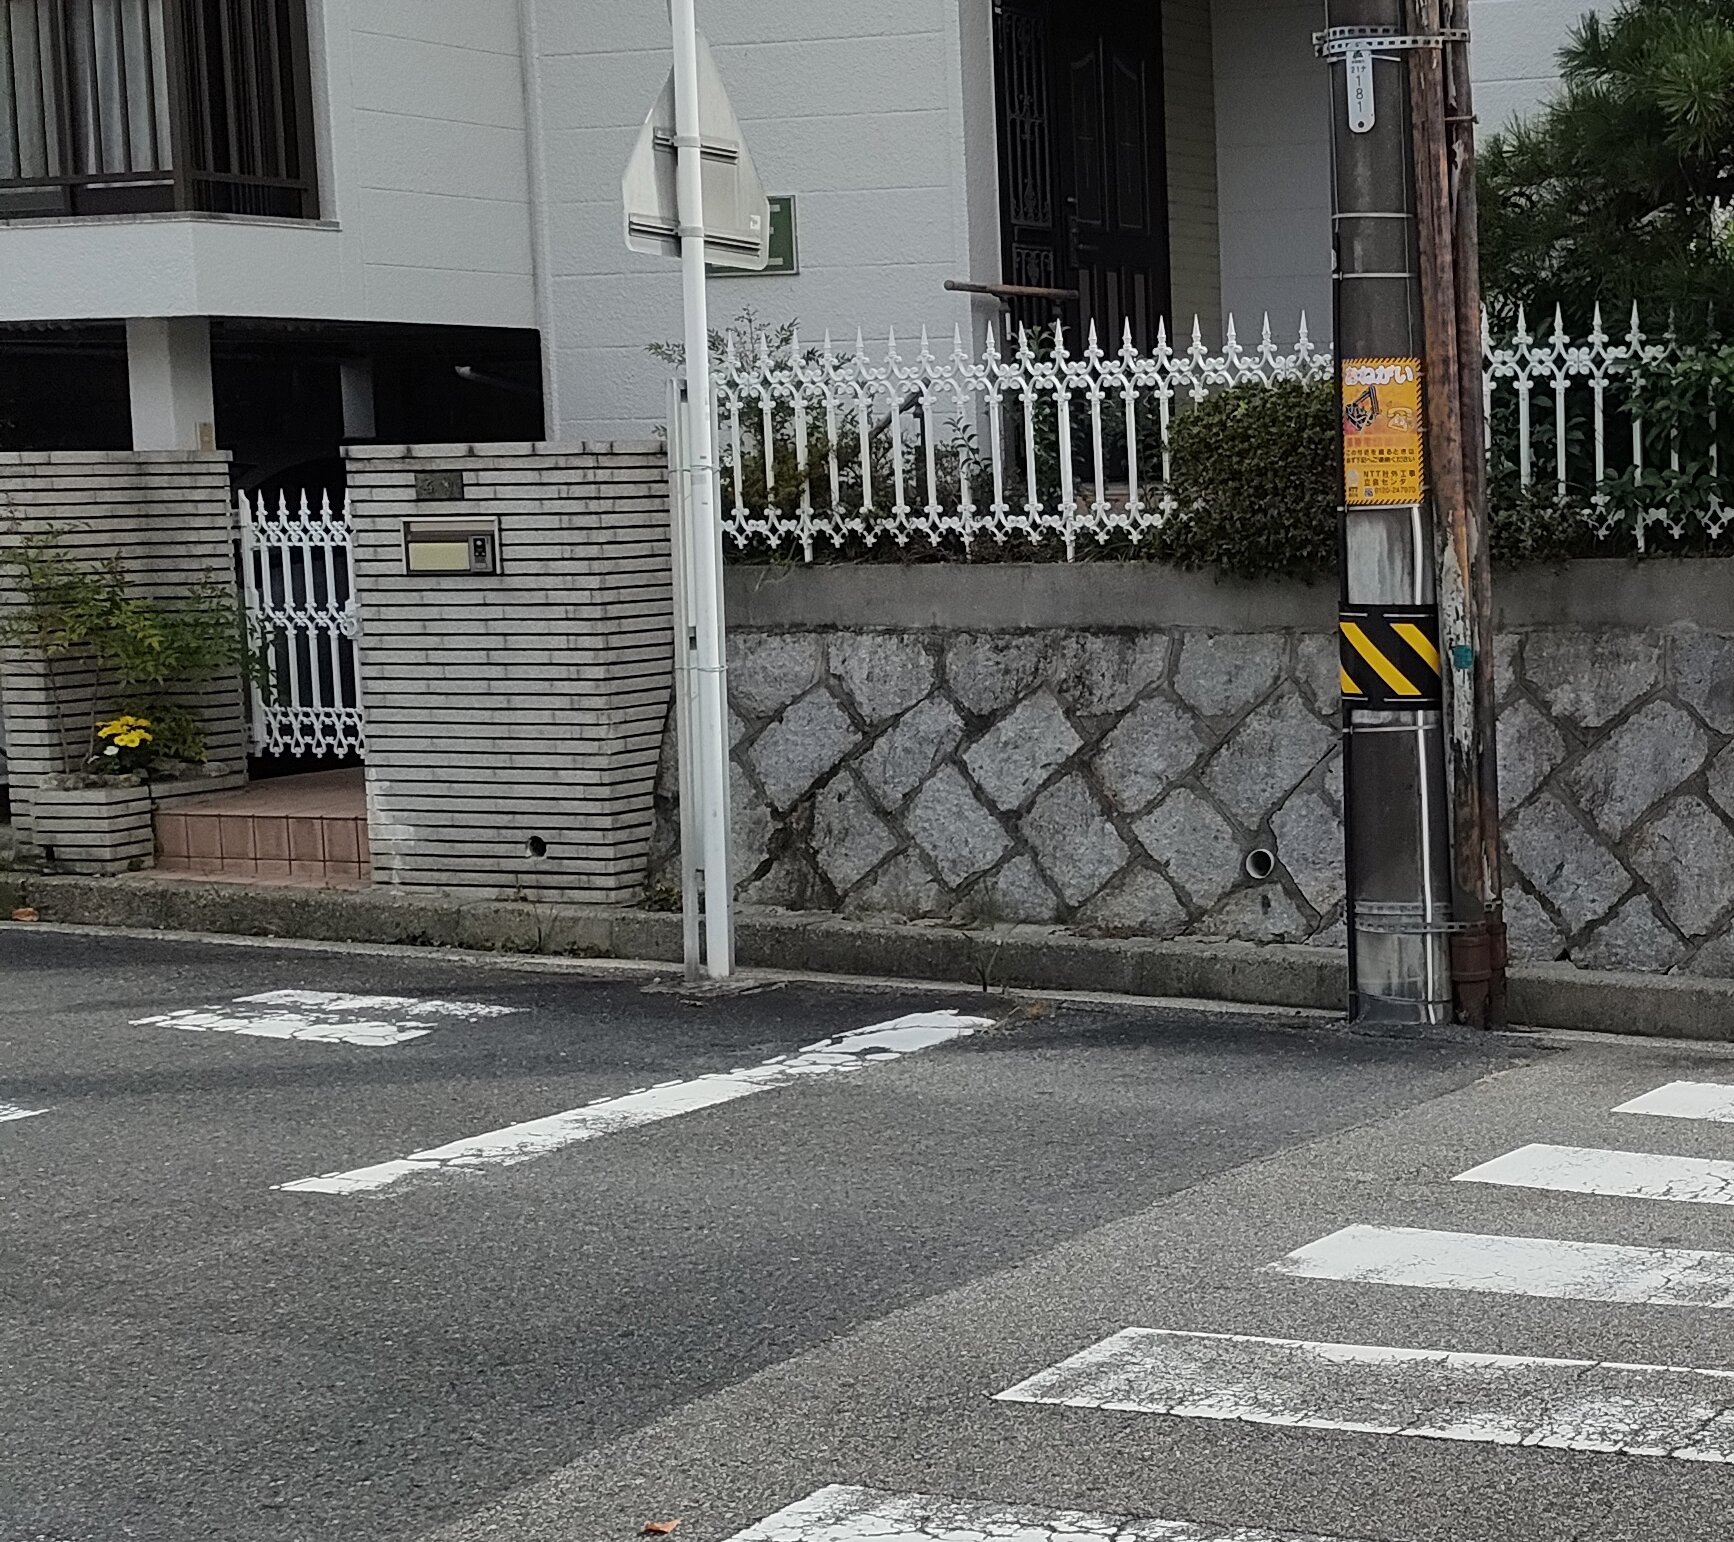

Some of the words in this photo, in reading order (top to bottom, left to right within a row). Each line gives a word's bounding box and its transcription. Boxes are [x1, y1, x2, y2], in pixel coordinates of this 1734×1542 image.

[1356, 75, 1364, 112] 181
[1344, 364, 1415, 385] おねがい
